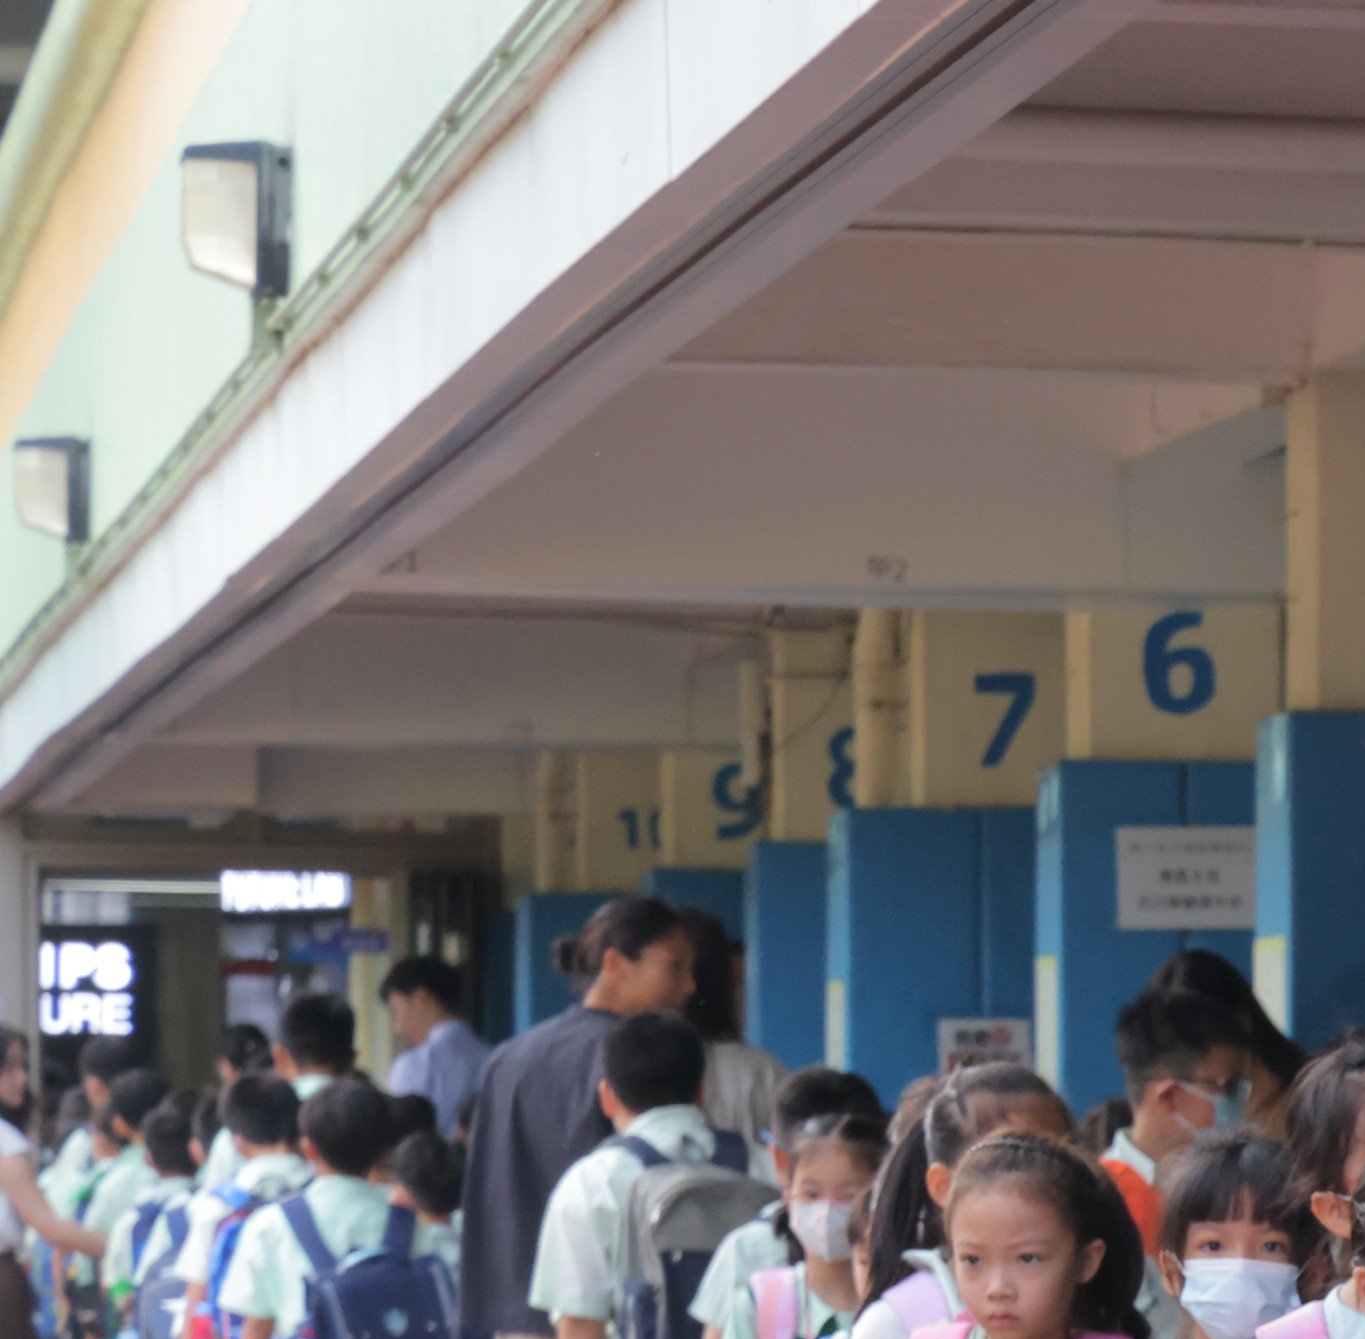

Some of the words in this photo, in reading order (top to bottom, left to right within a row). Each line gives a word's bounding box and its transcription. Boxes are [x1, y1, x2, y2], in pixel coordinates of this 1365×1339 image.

[1142, 611, 1216, 716] 6
[973, 672, 1037, 769] 7
[713, 763, 763, 839] 9
[39, 992, 135, 1036] URE
